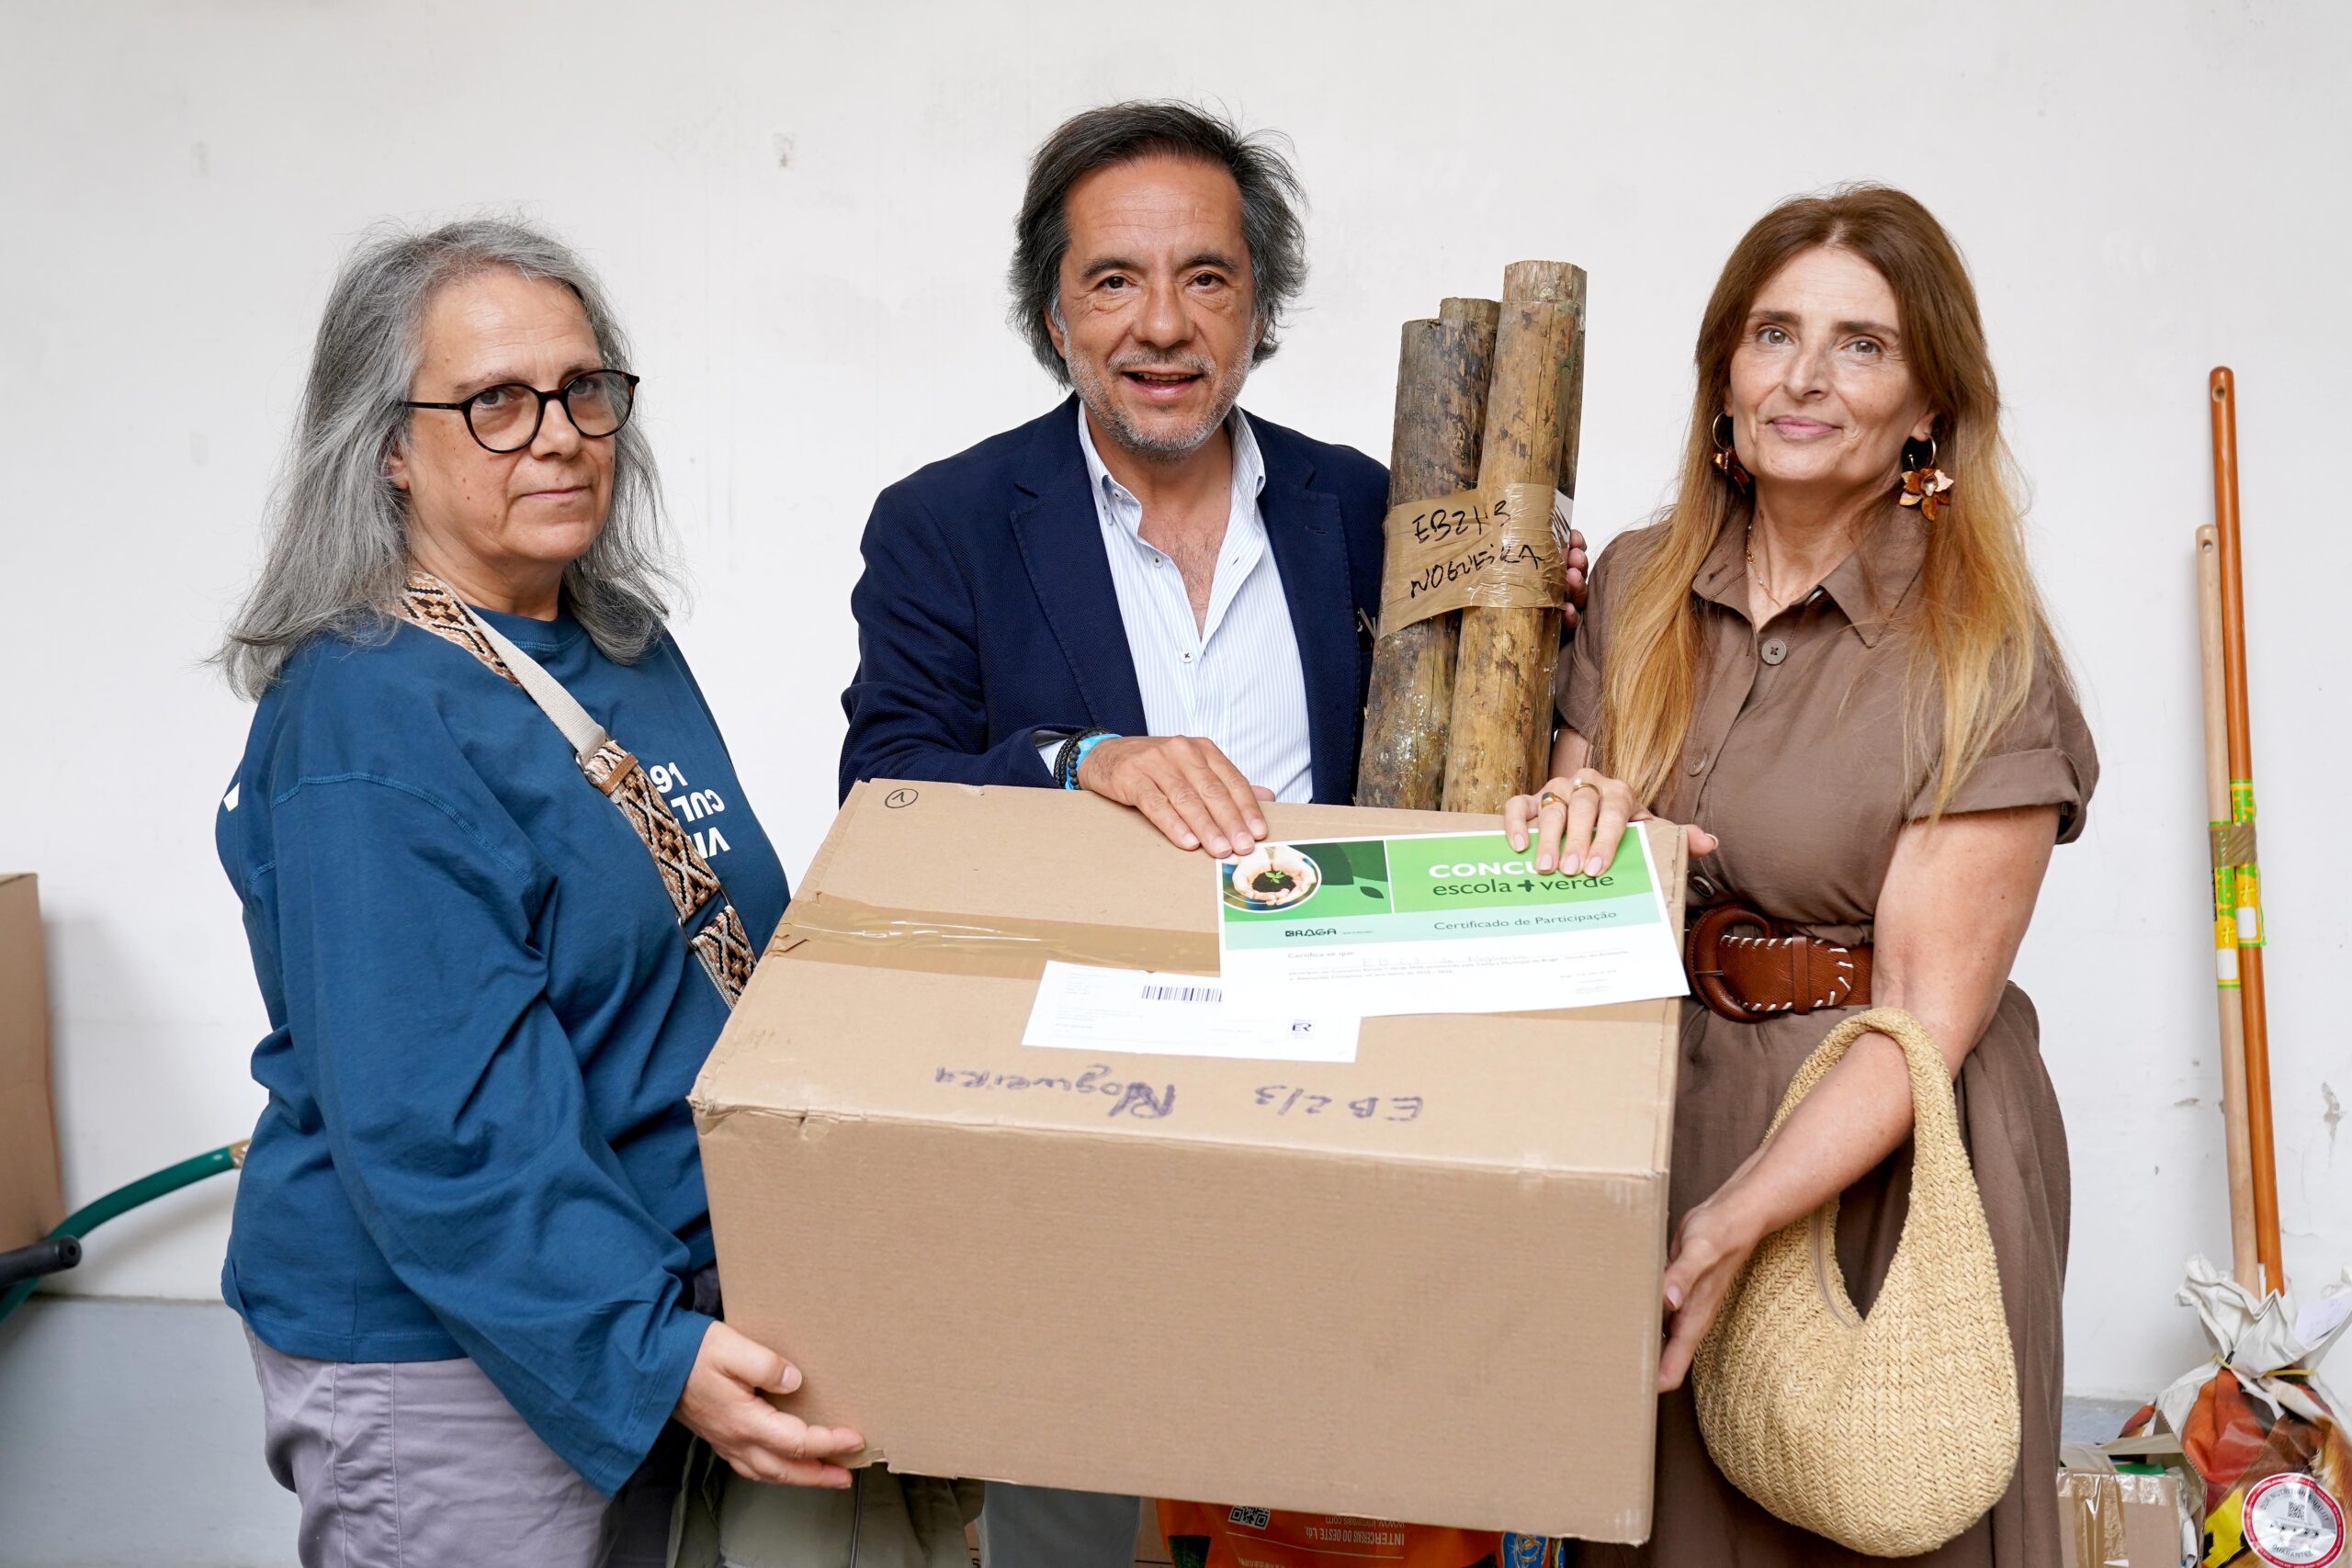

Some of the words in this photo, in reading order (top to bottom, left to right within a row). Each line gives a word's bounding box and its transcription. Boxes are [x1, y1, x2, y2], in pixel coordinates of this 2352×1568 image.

[670, 788, 726, 823] CUL
[1433, 878, 1511, 896] escola
[1540, 875, 1614, 891] verde
[1433, 918, 1510, 931] Certificado
[1514, 918, 1531, 927] de
[1535, 911, 1618, 926] Participação
[1284, 928, 1337, 937] BRAGA
